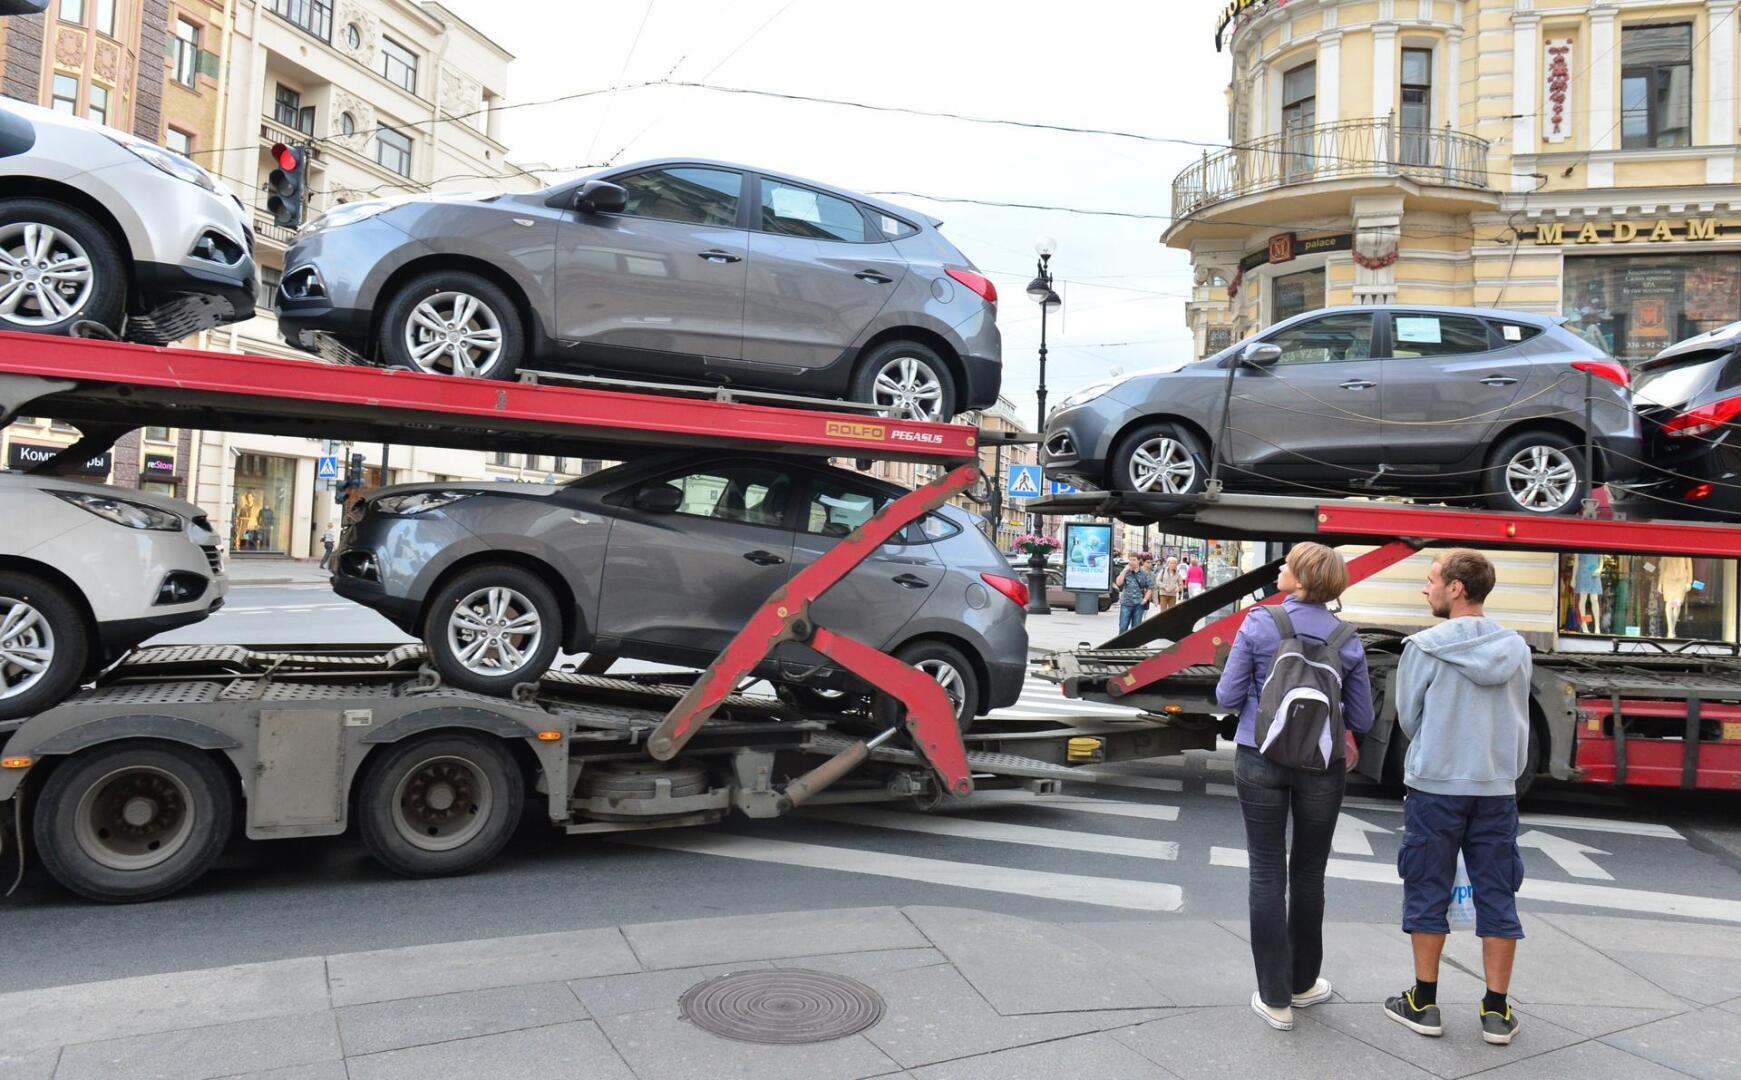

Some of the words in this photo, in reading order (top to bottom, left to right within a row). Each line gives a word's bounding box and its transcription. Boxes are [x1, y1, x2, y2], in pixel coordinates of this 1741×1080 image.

[1536, 218, 1717, 245] MADAM
[1305, 238, 1336, 250] palace
[828, 423, 883, 438] ROLFO
[891, 430, 943, 444] PEGASUS
